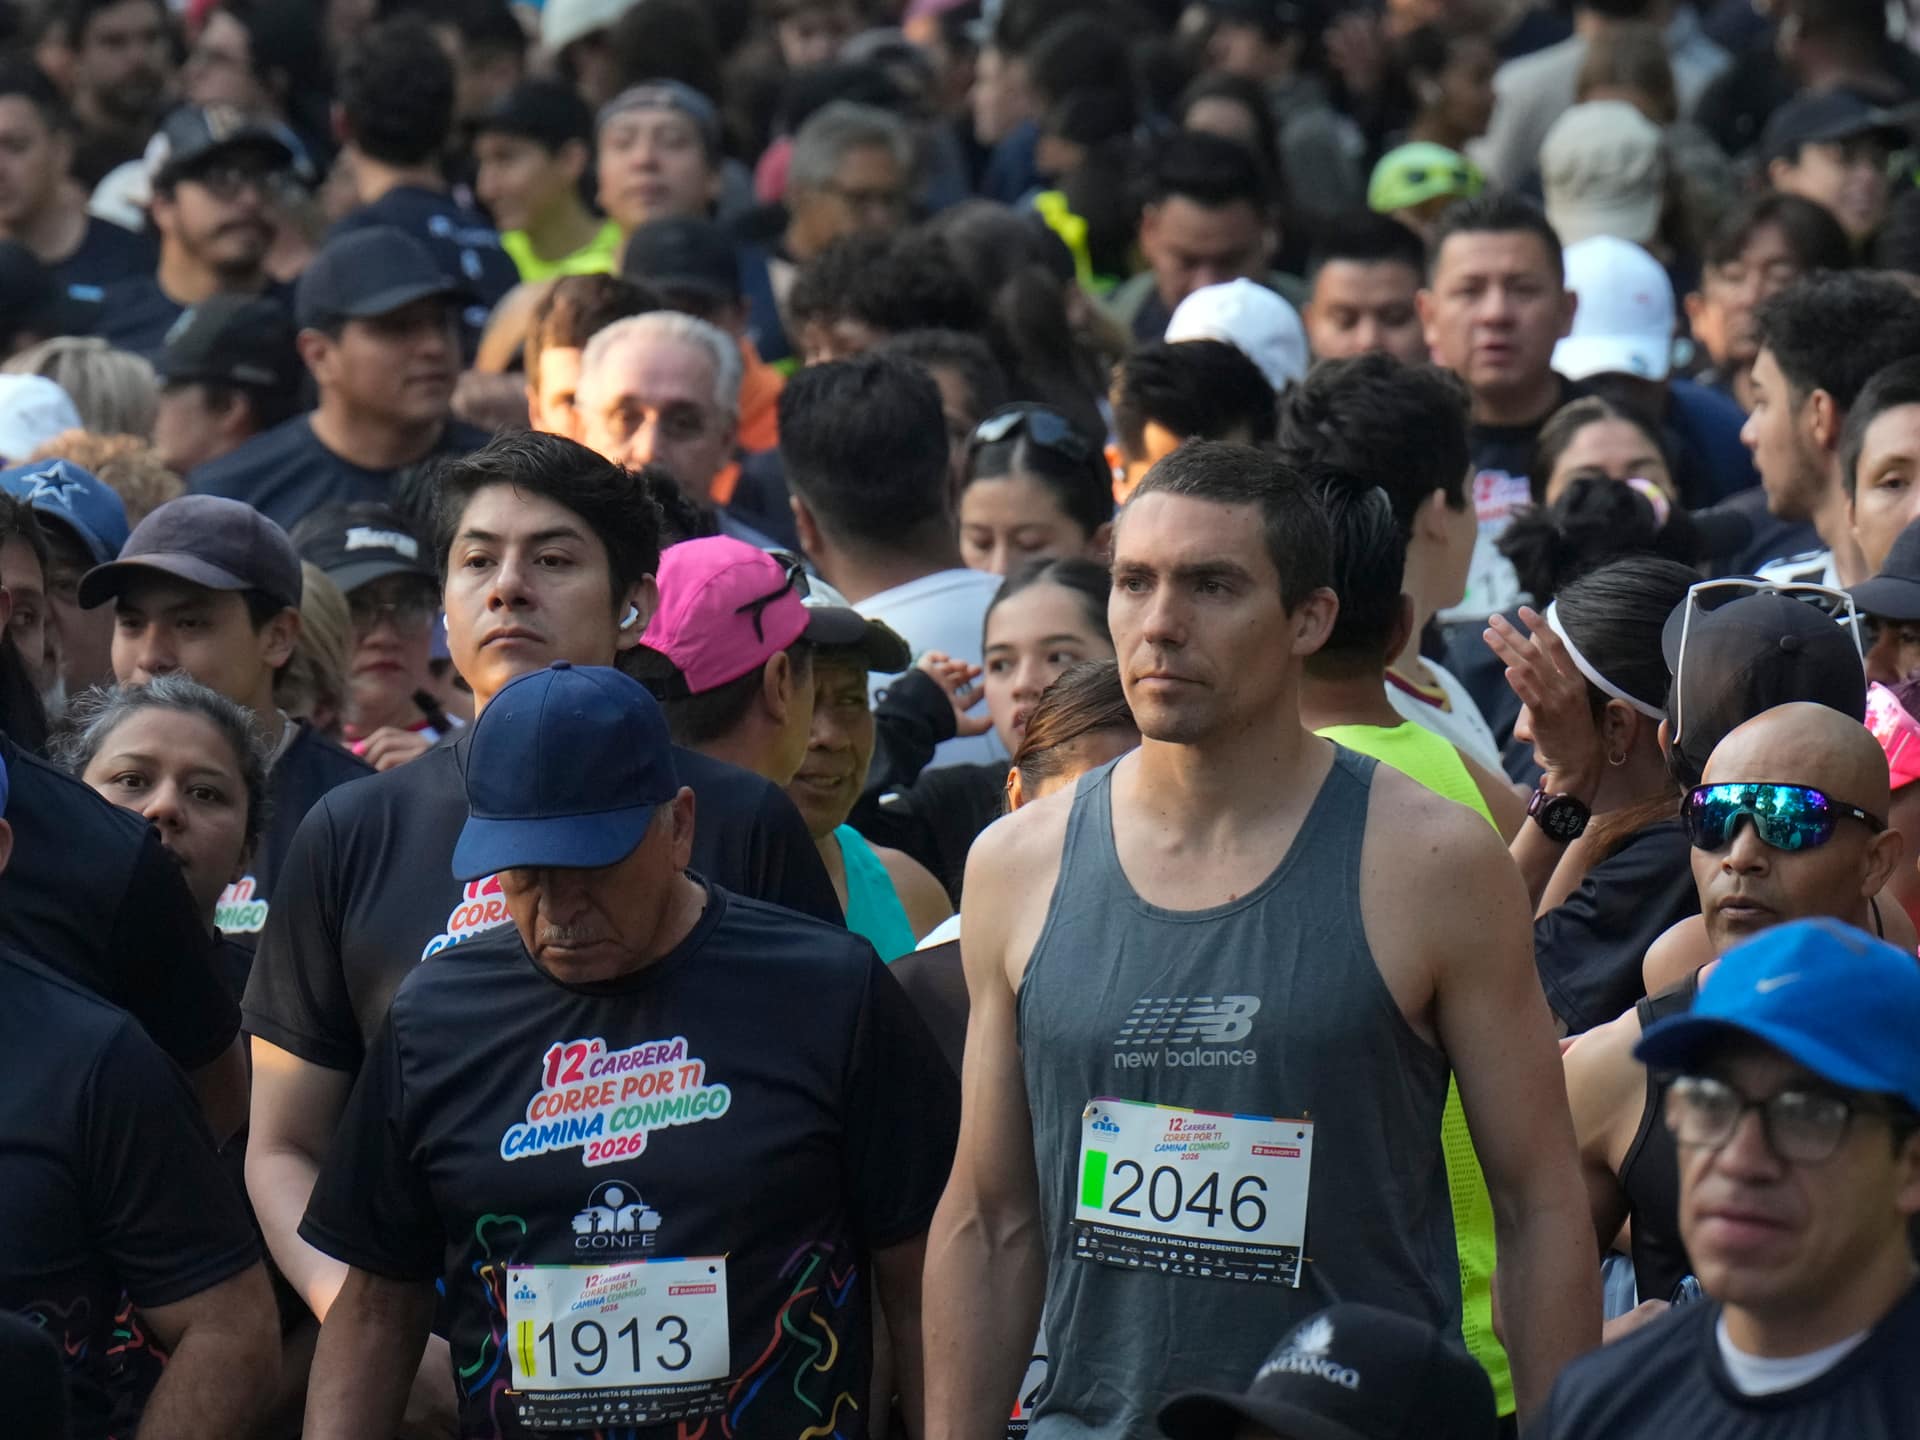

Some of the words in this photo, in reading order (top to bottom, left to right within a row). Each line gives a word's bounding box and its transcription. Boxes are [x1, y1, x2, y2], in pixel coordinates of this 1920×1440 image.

[589, 1041, 684, 1078] CARRERA
[1114, 1051, 1159, 1069] new
[1165, 1046, 1257, 1067] balance
[530, 1081, 617, 1121] CORRE
[621, 1071, 674, 1101] POR
[679, 1064, 701, 1090] TI
[504, 1113, 604, 1155] CAMINA
[610, 1089, 727, 1132] CONMIGO
[588, 1133, 642, 1161] 2026
[1194, 1132, 1212, 1141] POR
[1109, 1159, 1268, 1232] 2046
[575, 1233, 657, 1248] CONFE
[1188, 1241, 1199, 1249] DE
[538, 1315, 692, 1377] 1913
[589, 1391, 599, 1399] LA
